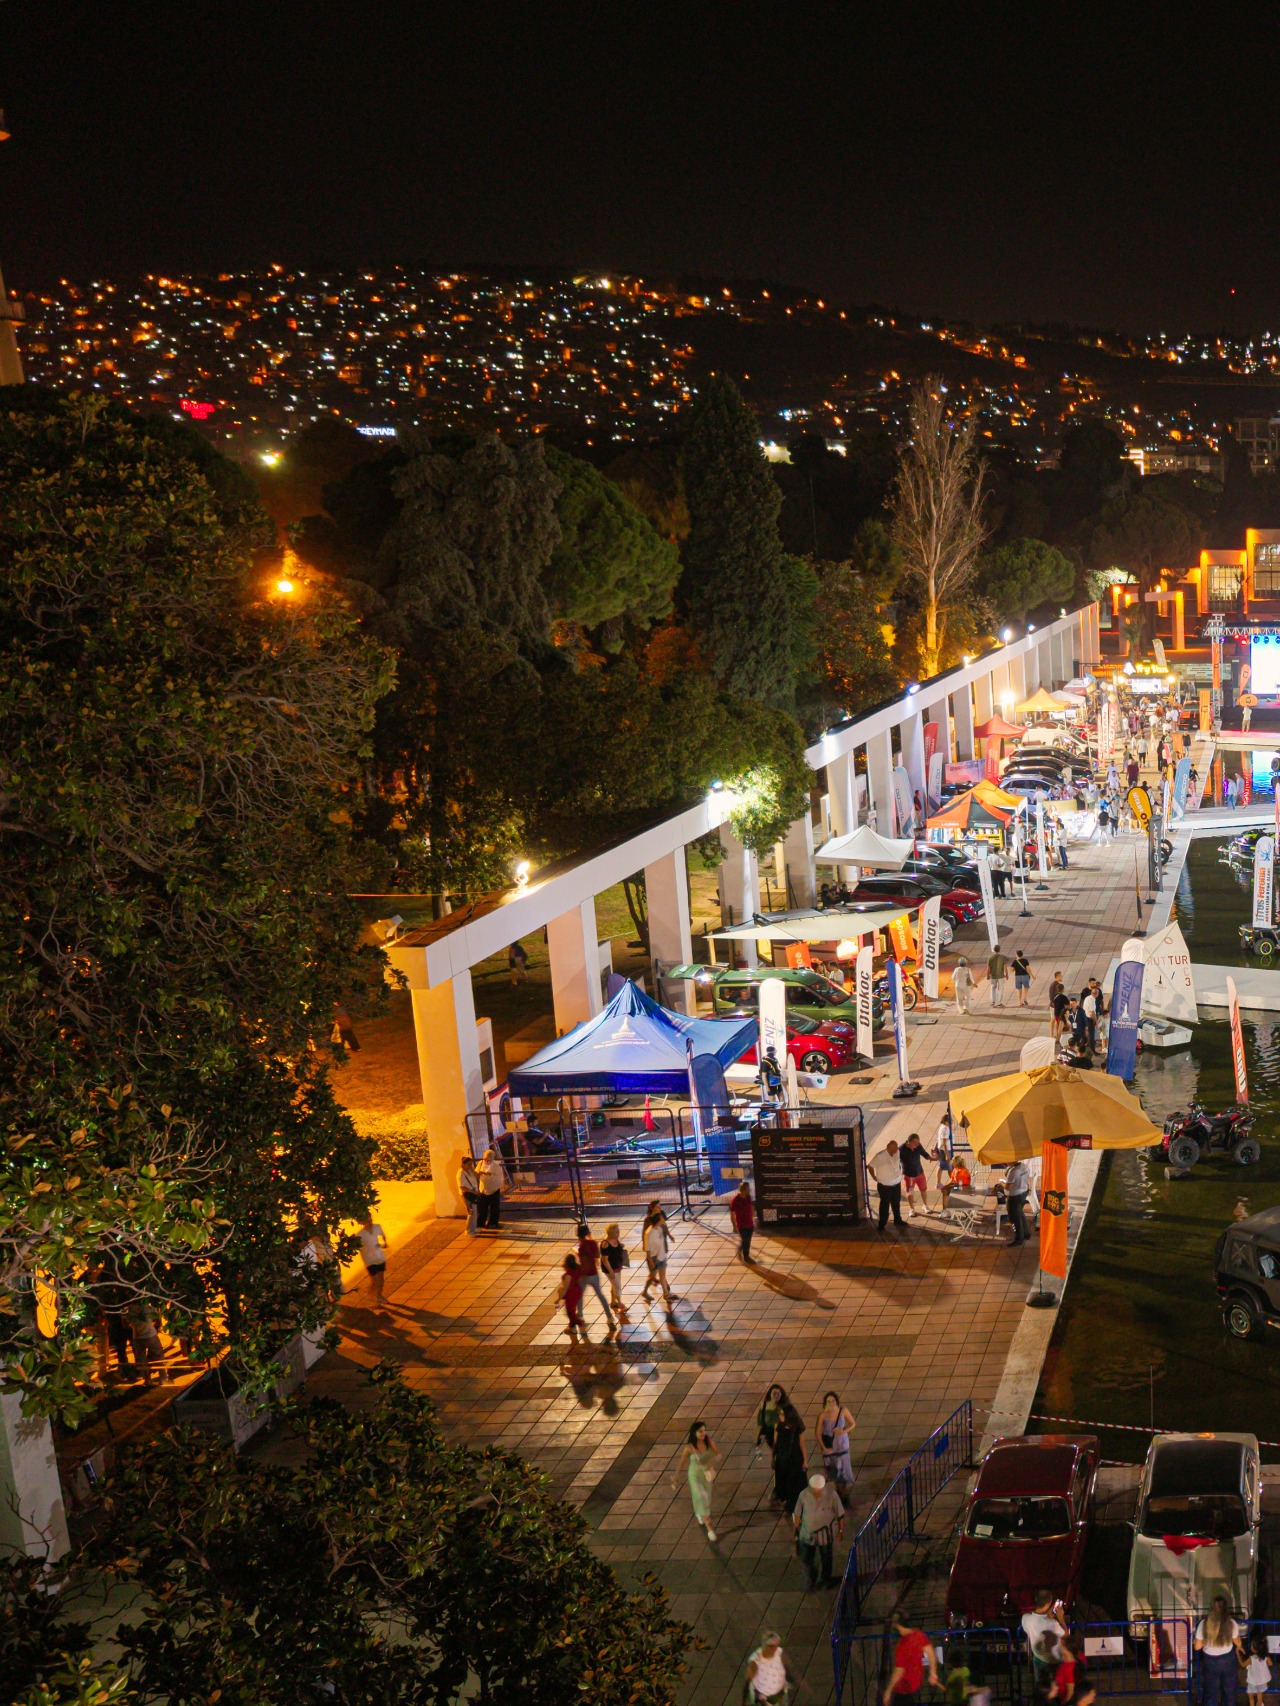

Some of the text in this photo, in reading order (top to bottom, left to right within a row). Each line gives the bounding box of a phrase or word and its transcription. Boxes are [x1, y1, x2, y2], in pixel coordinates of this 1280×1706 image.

[1136, 663, 1169, 675] Try Van
[1168, 955, 1189, 965] TUR
[1185, 977, 1191, 986] 3
